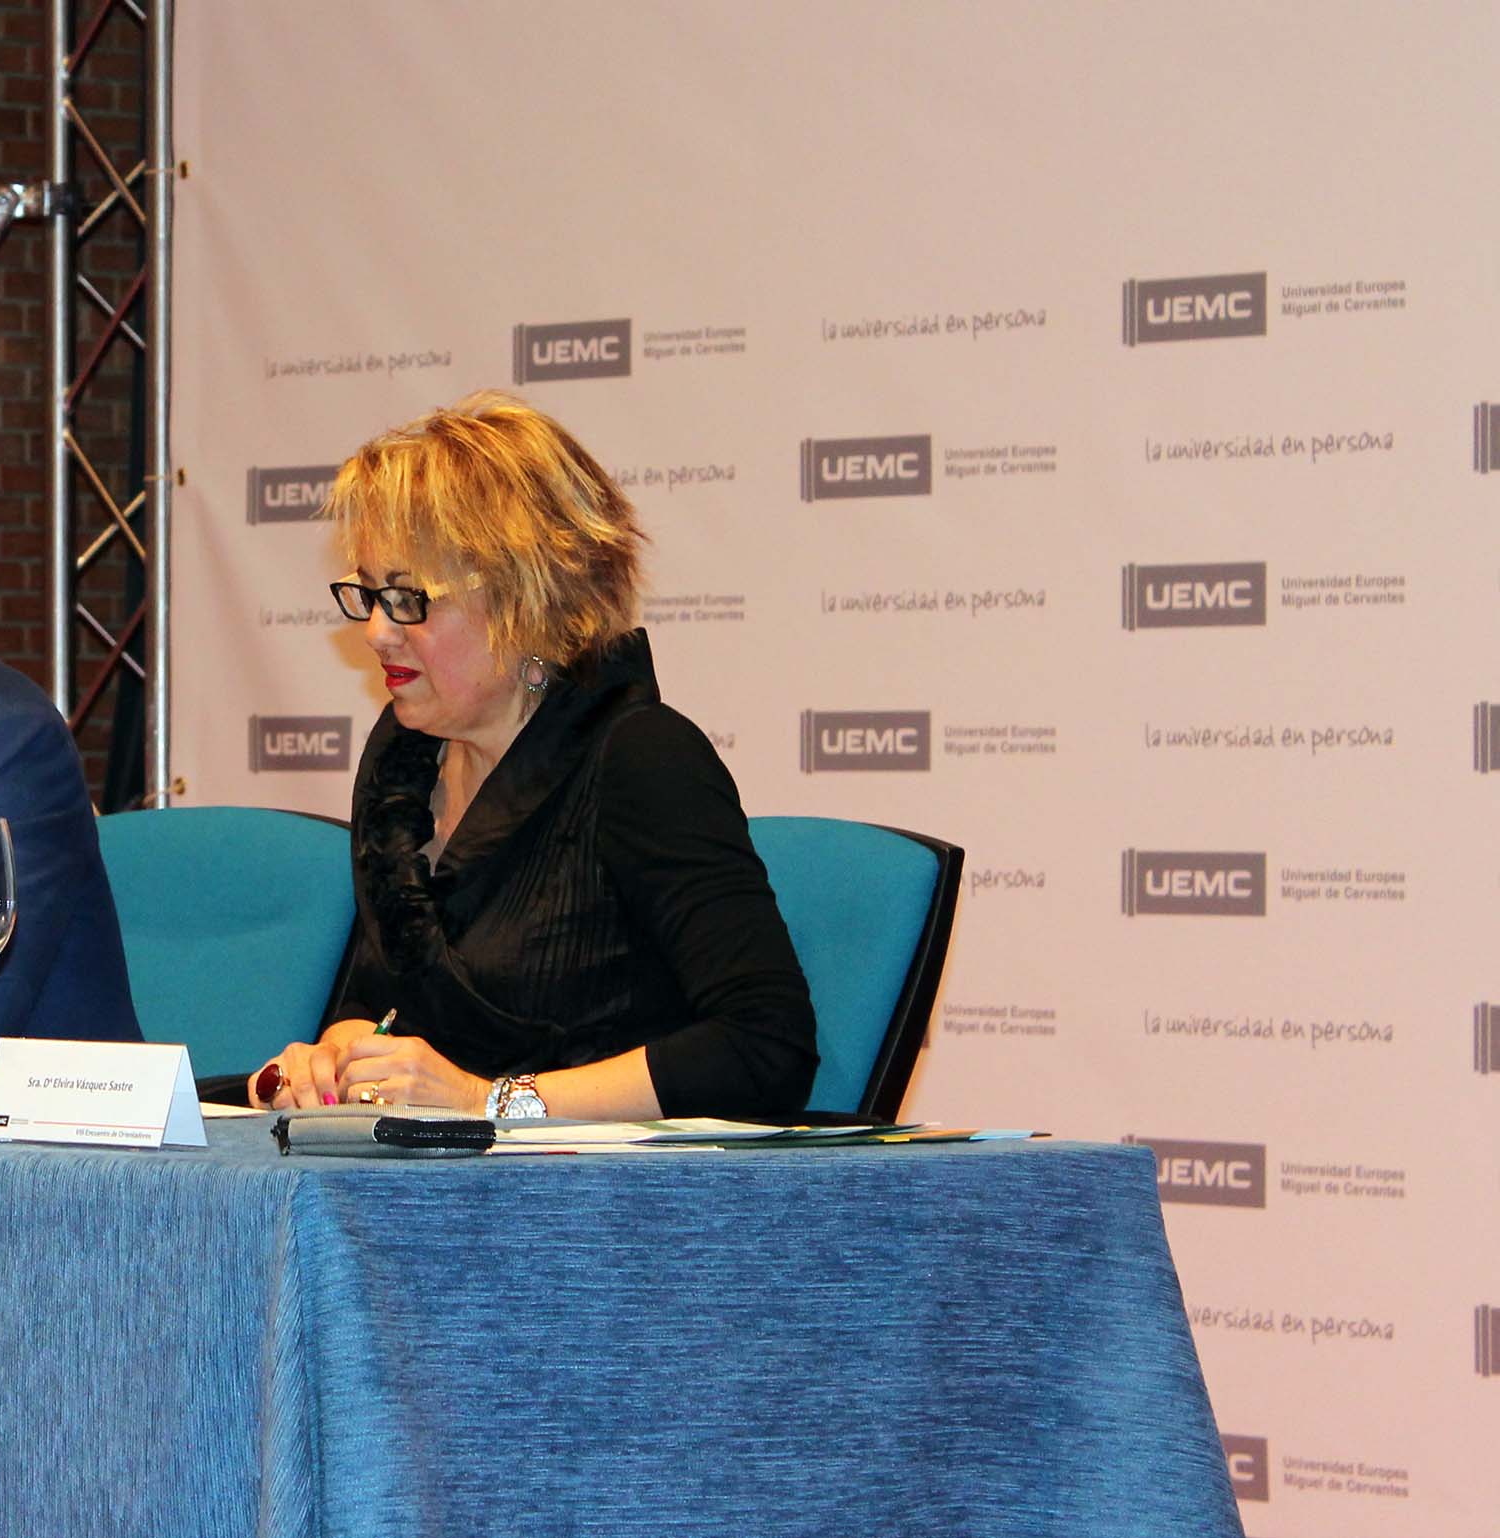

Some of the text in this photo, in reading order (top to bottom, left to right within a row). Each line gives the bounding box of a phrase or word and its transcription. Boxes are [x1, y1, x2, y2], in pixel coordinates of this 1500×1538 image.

[1282, 280, 1406, 298] Universidad Europea
[1147, 291, 1252, 324] UEMC
[1282, 296, 1406, 318] Miguel de Cervantes
[822, 309, 1046, 342] la universidad en persona
[532, 336, 620, 365] UEMC
[388, 350, 452, 379] persona
[945, 445, 1057, 460] Universidad Europea
[1146, 432, 1393, 464] la universidad en persona
[644, 468, 664, 486] en
[668, 464, 735, 492] persona
[822, 453, 918, 482] UEMC
[945, 460, 1057, 479] Miguel de Cervantes
[1281, 574, 1405, 590] Universidad Europea
[822, 589, 1045, 617] la universidad en persona
[1146, 580, 1252, 610] UEMC
[1282, 590, 1406, 609] Miguel de Cervantes
[265, 731, 340, 756] UEMC
[822, 728, 917, 754] UEMC
[944, 725, 1056, 739] Universidad Europea
[1146, 723, 1393, 756] la universidad en persona
[944, 741, 1056, 756] Miguel de Cervantes
[971, 869, 1045, 896] persona
[1146, 870, 1252, 897] UEMC
[1281, 869, 1405, 885] Universidad Europea
[1281, 885, 1405, 902] Miguel de Cervantes
[943, 1004, 1056, 1020] Universidad Europea
[944, 1020, 1056, 1036] Miguel de Cervantes
[1145, 1010, 1393, 1049] la universidad en persona
[28, 1077, 41, 1087] Sra.
[53, 1078, 74, 1088] Elvira
[77, 1080, 107, 1092] Vázquez
[109, 1081, 133, 1091] Sastre
[1281, 1162, 1405, 1180] Universidad Europea
[1281, 1178, 1405, 1198] Miguel de Cervantes
[1191, 1307, 1394, 1344] versidad en persona
[1283, 1456, 1408, 1480] Universidad Europea
[1284, 1473, 1409, 1498] Miguel de Cervantes
